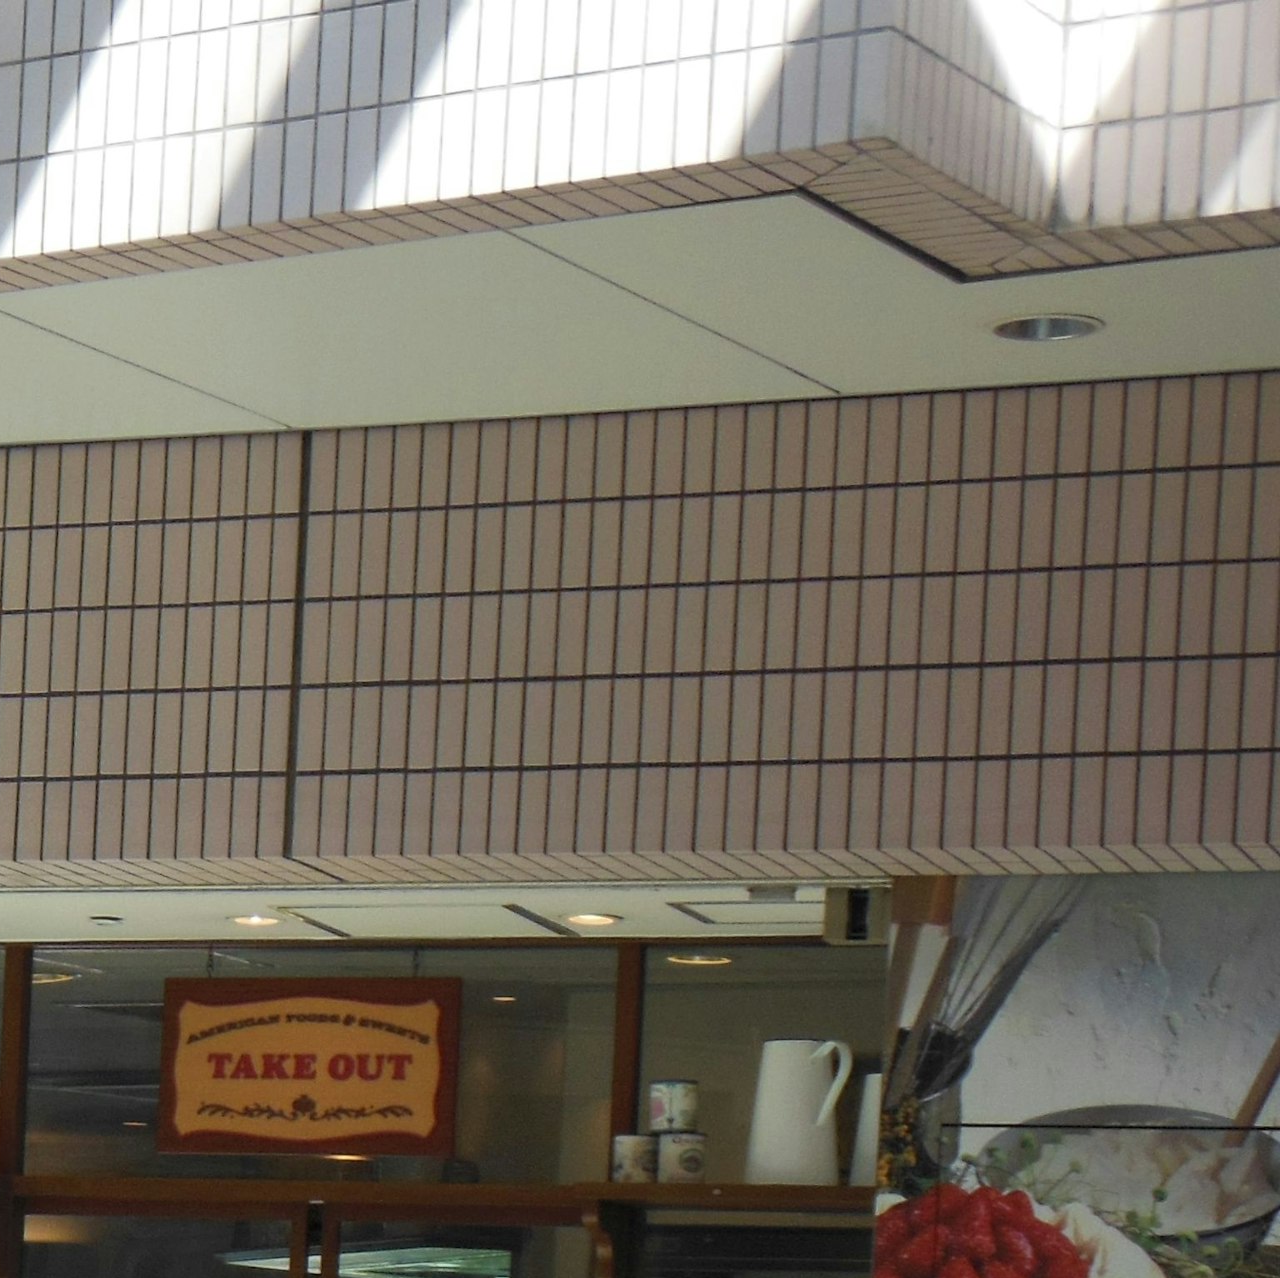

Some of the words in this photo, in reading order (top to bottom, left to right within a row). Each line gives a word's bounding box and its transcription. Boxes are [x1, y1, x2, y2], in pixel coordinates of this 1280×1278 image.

[185, 1013, 281, 1046] AMERICAN
[285, 1012, 341, 1025] FOODS
[358, 1016, 433, 1046] SWEETS
[207, 1053, 318, 1081] TAKE
[327, 1053, 414, 1082] OUT
